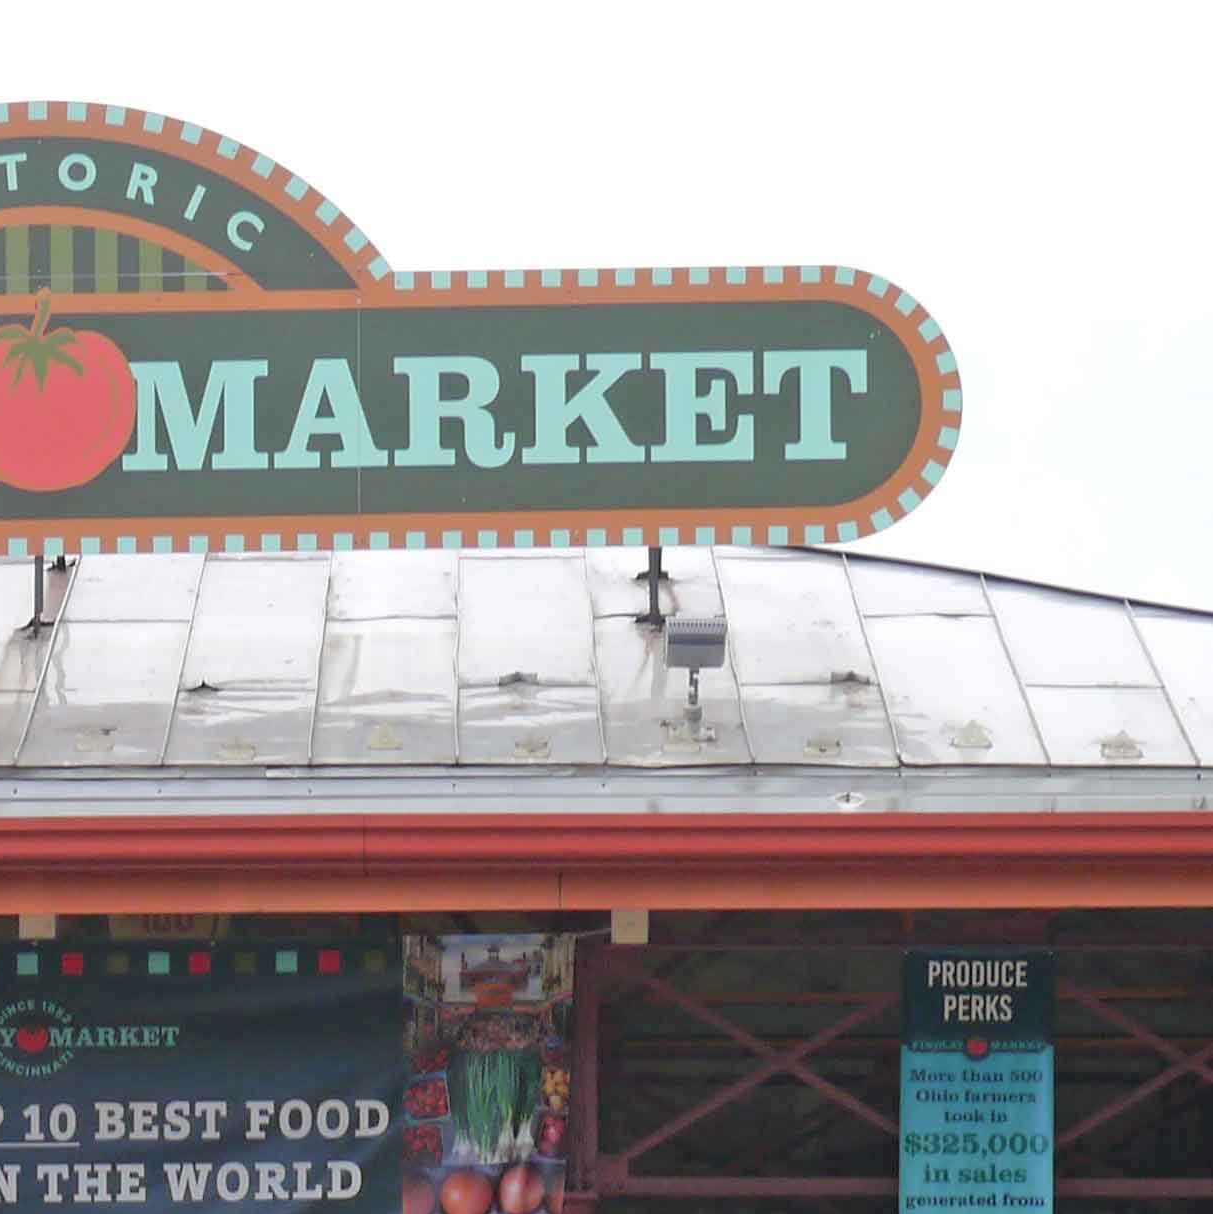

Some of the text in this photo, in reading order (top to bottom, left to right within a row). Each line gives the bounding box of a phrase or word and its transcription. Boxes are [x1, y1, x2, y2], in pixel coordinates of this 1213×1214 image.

[122, 350, 868, 474] MARKET
[928, 960, 1028, 988] PRODUCE
[943, 995, 1013, 1022] PERKS
[48, 1026, 180, 1048] MARKET
[910, 1069, 956, 1082] More
[962, 1068, 1004, 1082] than
[915, 1088, 1036, 1103] Ohio farmers
[22, 1103, 78, 1142] 10
[94, 1101, 227, 1141] BEST
[245, 1099, 390, 1140] FOOD
[944, 1109, 1008, 1123] took in
[904, 1130, 1050, 1158] $325,000
[37, 1163, 147, 1203] THE
[163, 1161, 363, 1201] WORLD
[924, 1163, 1028, 1184] in sales
[906, 1193, 1045, 1210] generated from
